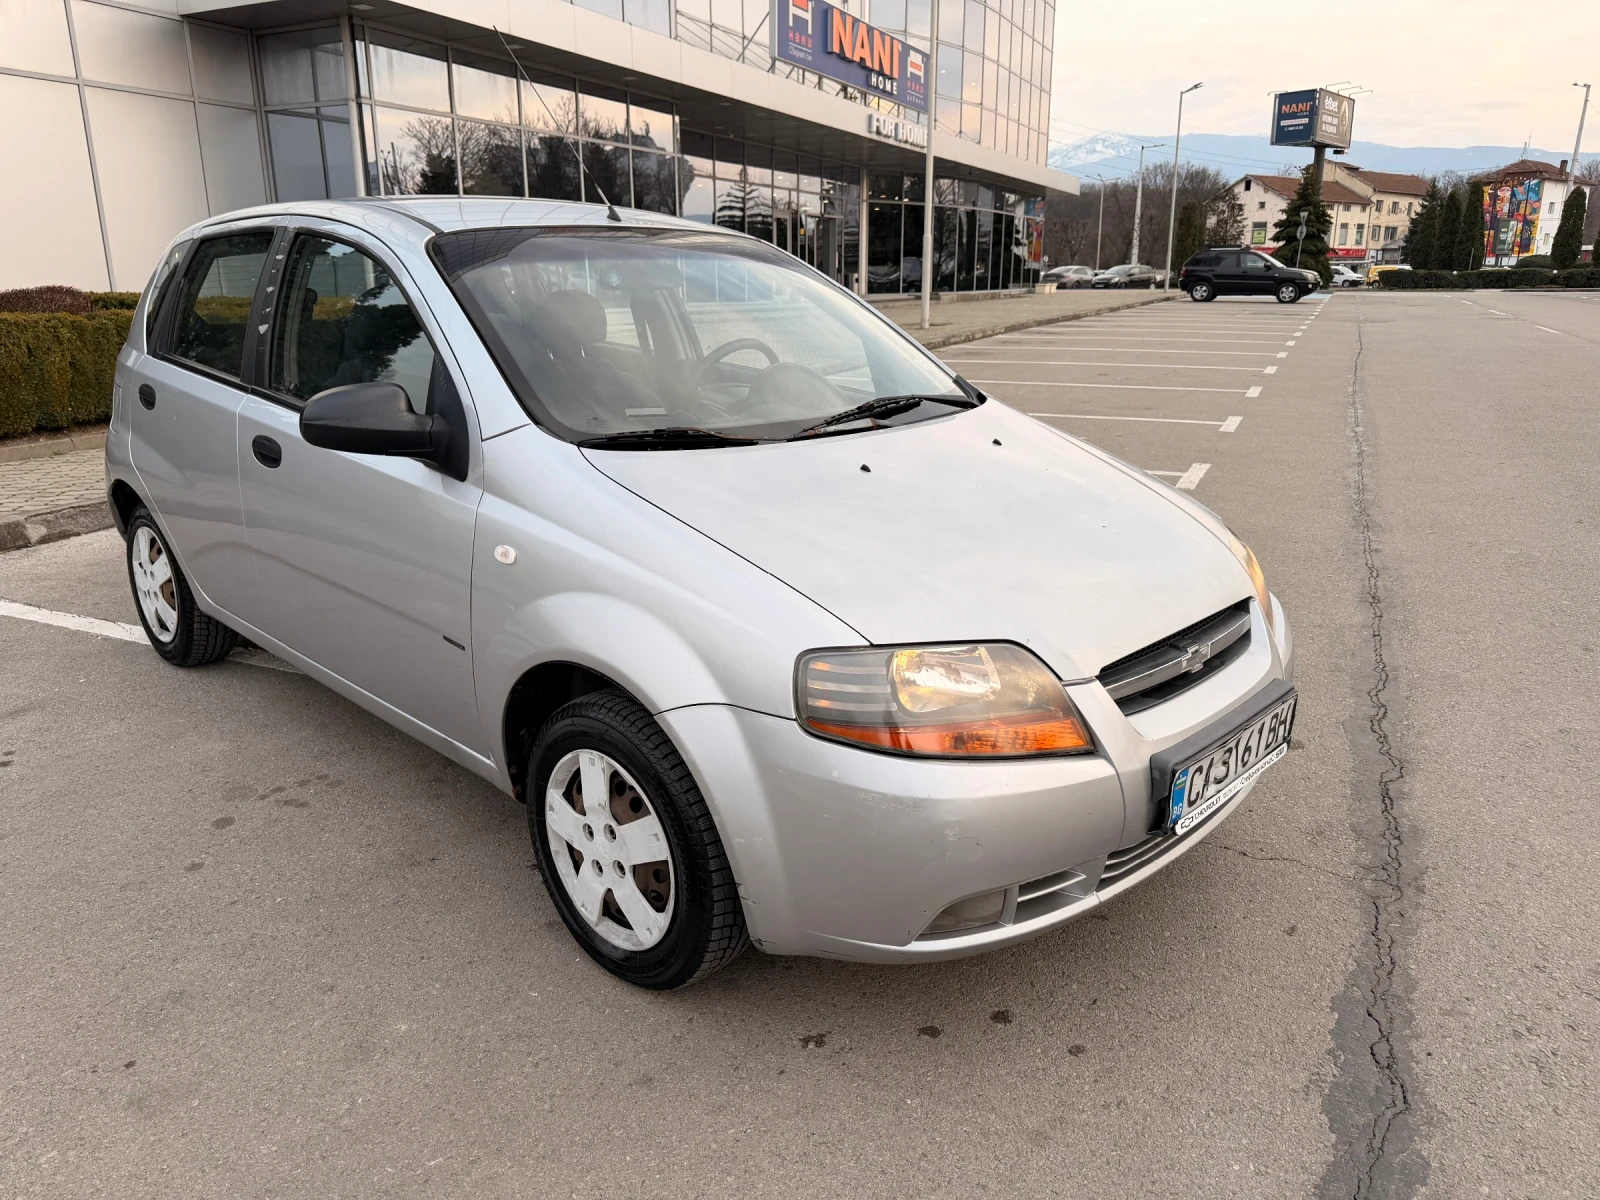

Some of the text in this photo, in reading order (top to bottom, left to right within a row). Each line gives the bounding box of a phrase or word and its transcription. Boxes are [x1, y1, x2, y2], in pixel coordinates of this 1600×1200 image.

[832, 7, 899, 80] NANI
[871, 72, 898, 95] HOME
[1281, 102, 1311, 114] NANI
[872, 114, 896, 138] FOR
[1172, 803, 1183, 820] BG
[1194, 796, 1222, 820] CHEVROLET
